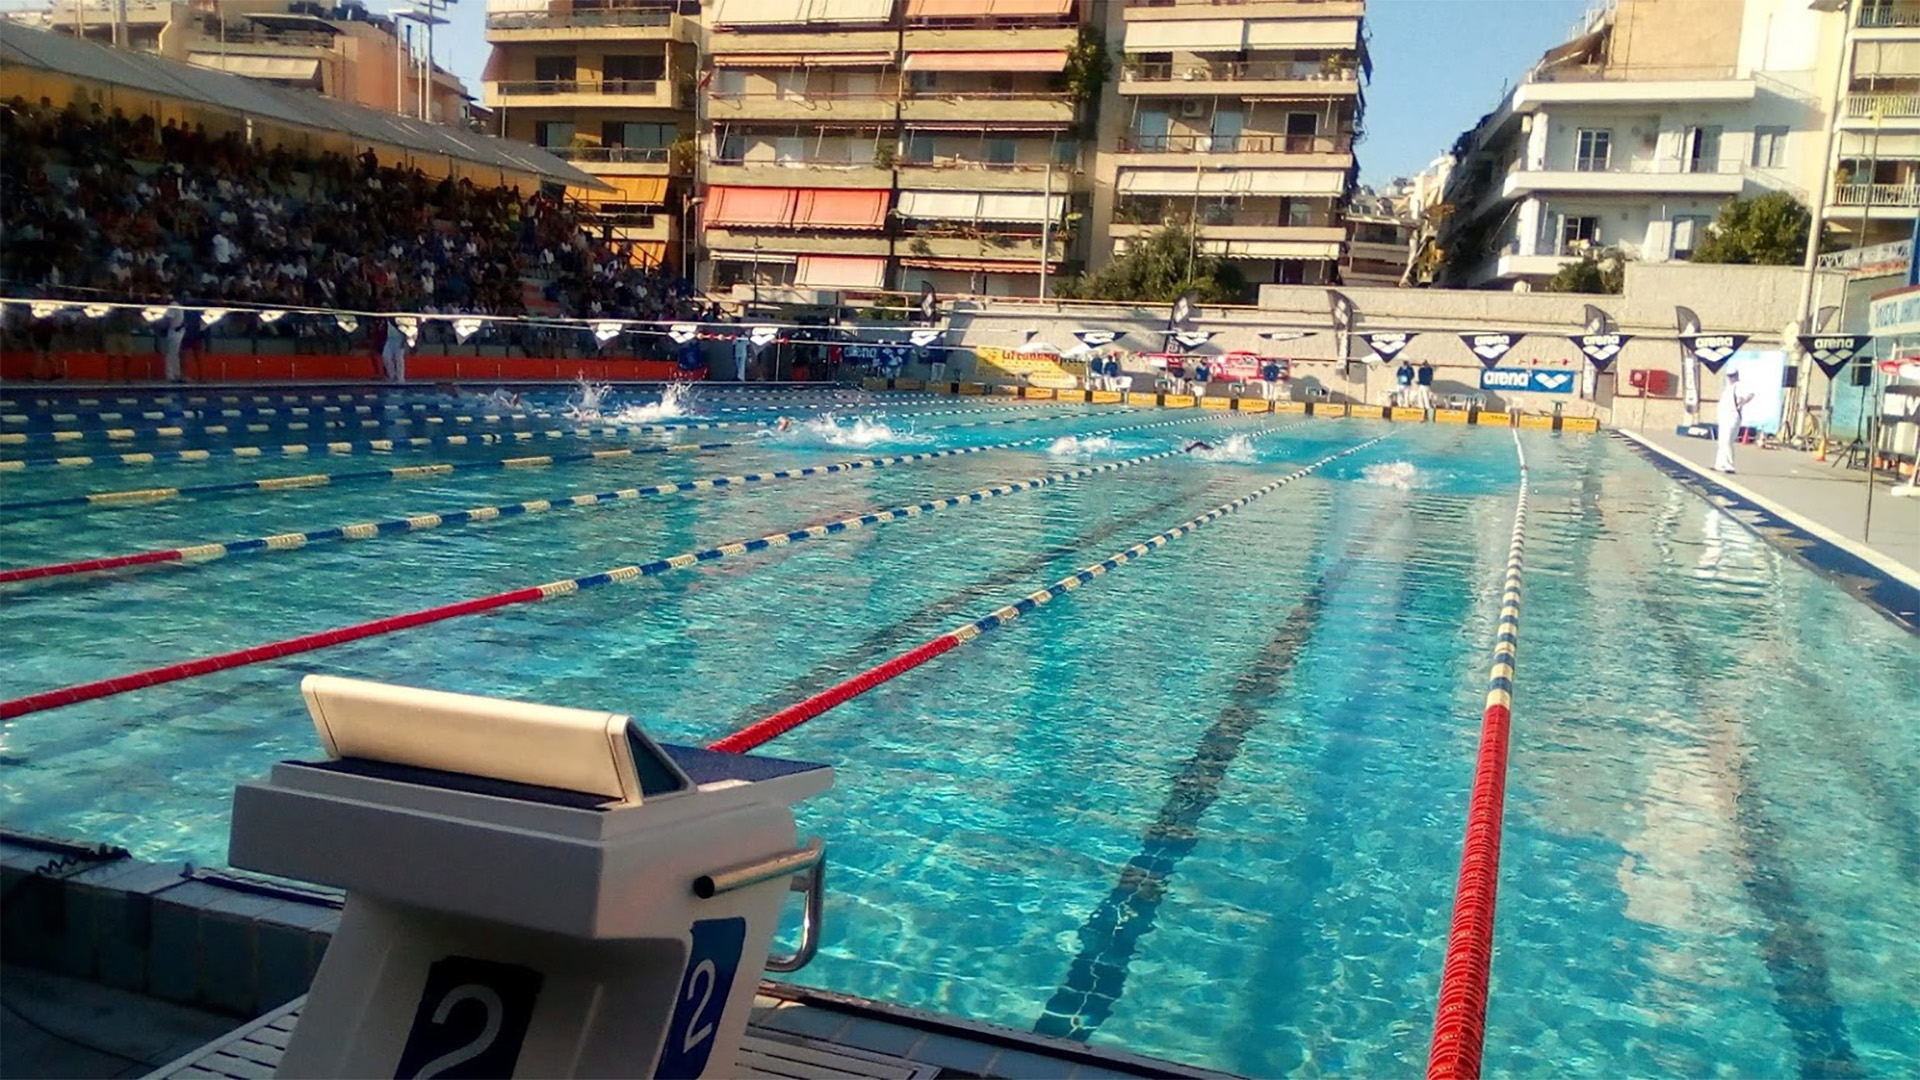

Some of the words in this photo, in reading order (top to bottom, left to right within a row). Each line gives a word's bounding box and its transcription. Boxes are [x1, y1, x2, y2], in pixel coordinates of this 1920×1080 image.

[1583, 335, 1620, 346] arena
[1694, 336, 1733, 347] arena
[1814, 338, 1854, 349] arena
[1483, 371, 1529, 387] arena
[683, 958, 716, 1054] 2
[411, 983, 504, 1080] 2
